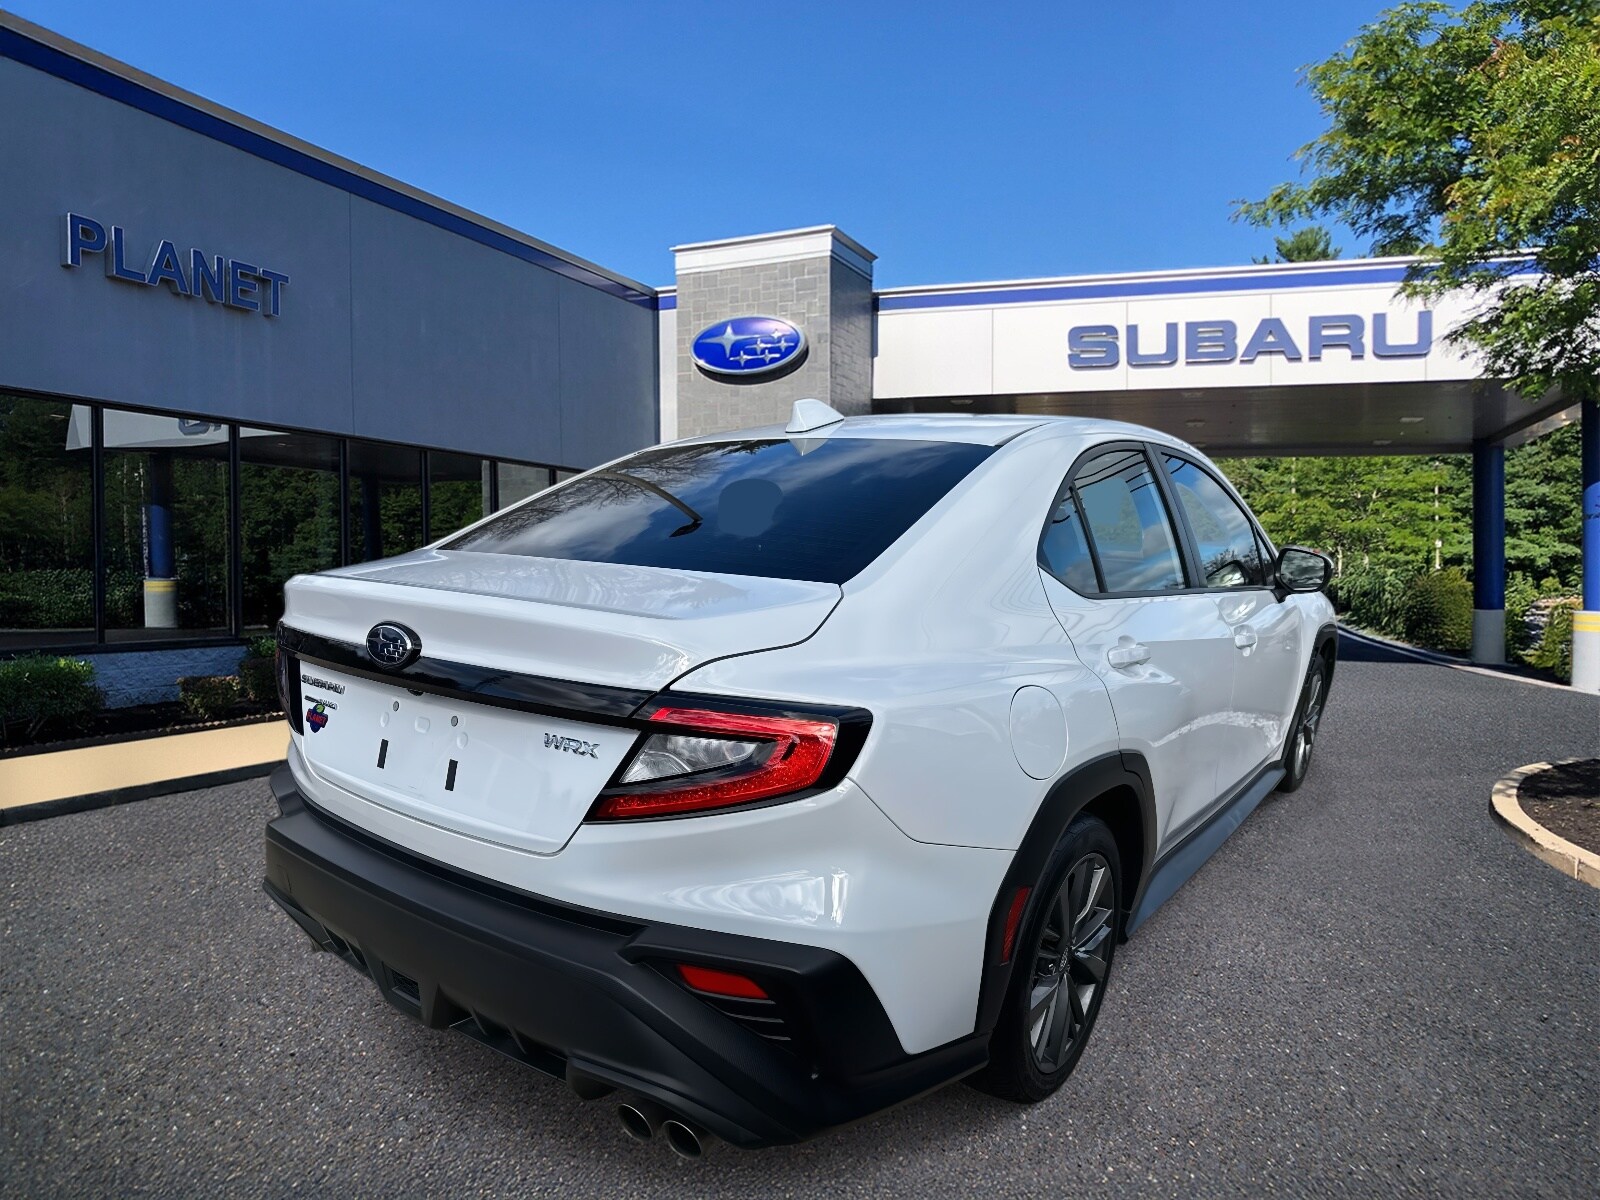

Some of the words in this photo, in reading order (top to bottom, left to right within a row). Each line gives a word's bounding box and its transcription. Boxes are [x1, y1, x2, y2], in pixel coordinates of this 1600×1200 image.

[65, 212, 290, 317] PLANET
[1067, 310, 1433, 369] SUBARU
[544, 732, 600, 759] WRX
